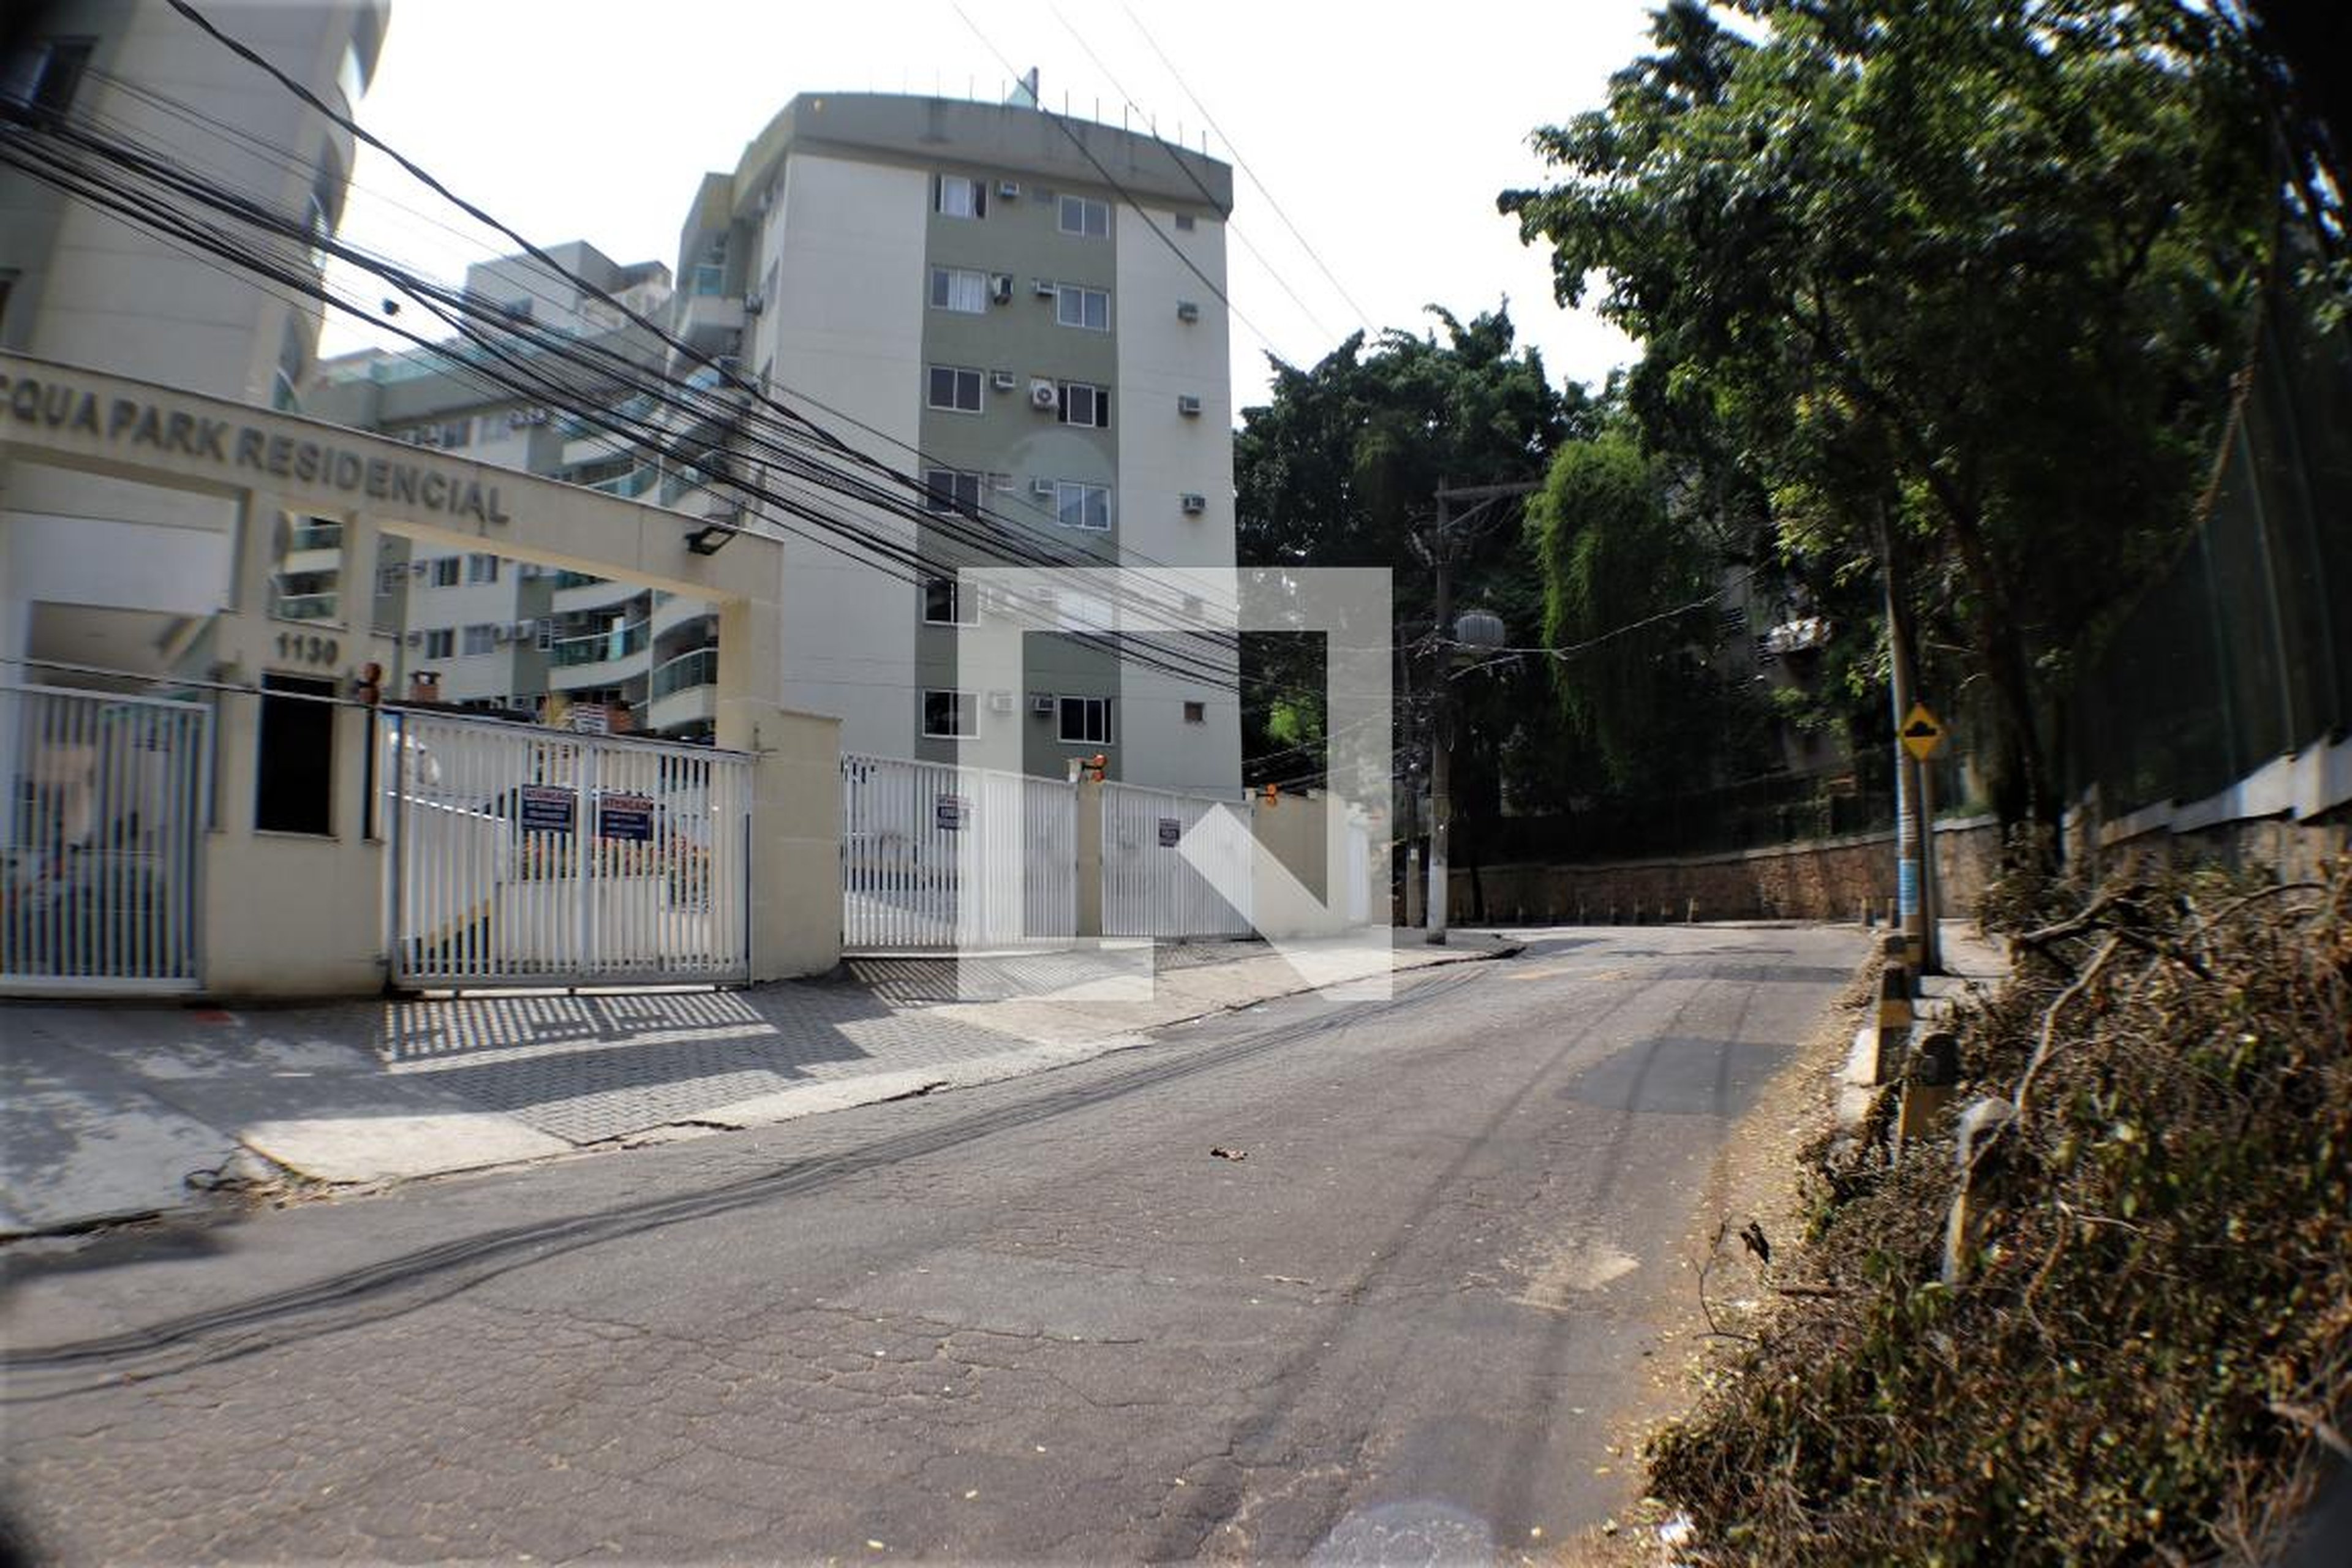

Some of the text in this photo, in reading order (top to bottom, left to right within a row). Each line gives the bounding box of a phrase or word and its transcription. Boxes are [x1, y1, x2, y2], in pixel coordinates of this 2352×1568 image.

[107, 398, 229, 463] PARK
[236, 423, 511, 525] RESIDENCIAL
[276, 631, 339, 668] 1130
